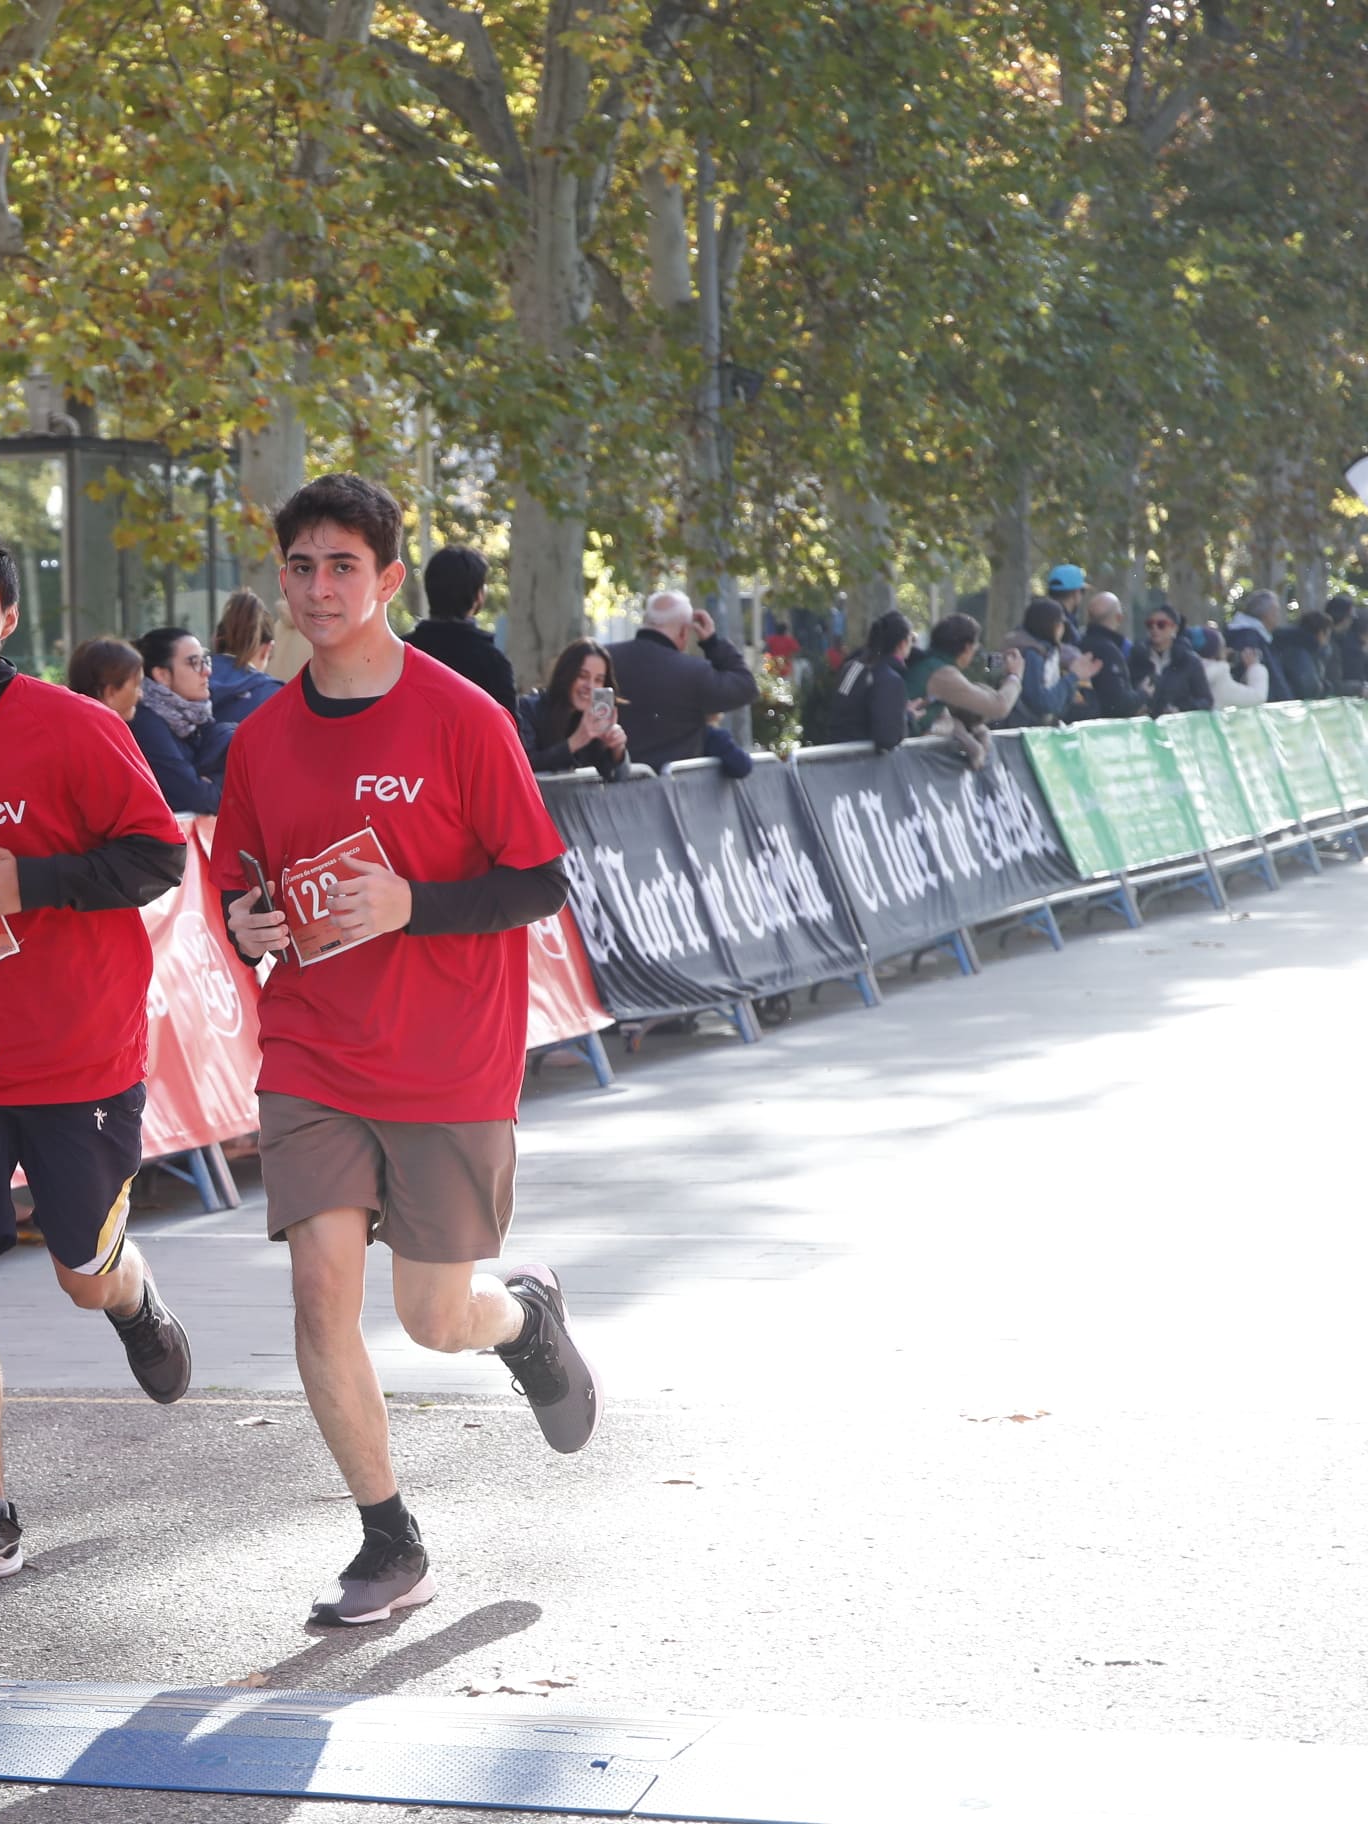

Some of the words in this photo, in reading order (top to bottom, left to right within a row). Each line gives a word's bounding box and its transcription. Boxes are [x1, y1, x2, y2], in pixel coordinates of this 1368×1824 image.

[833, 794, 889, 912] El
[860, 784, 954, 905] Norte
[928, 782, 981, 879] de
[595, 845, 709, 964] Norte
[686, 842, 740, 943] de
[720, 825, 832, 939] Castilla
